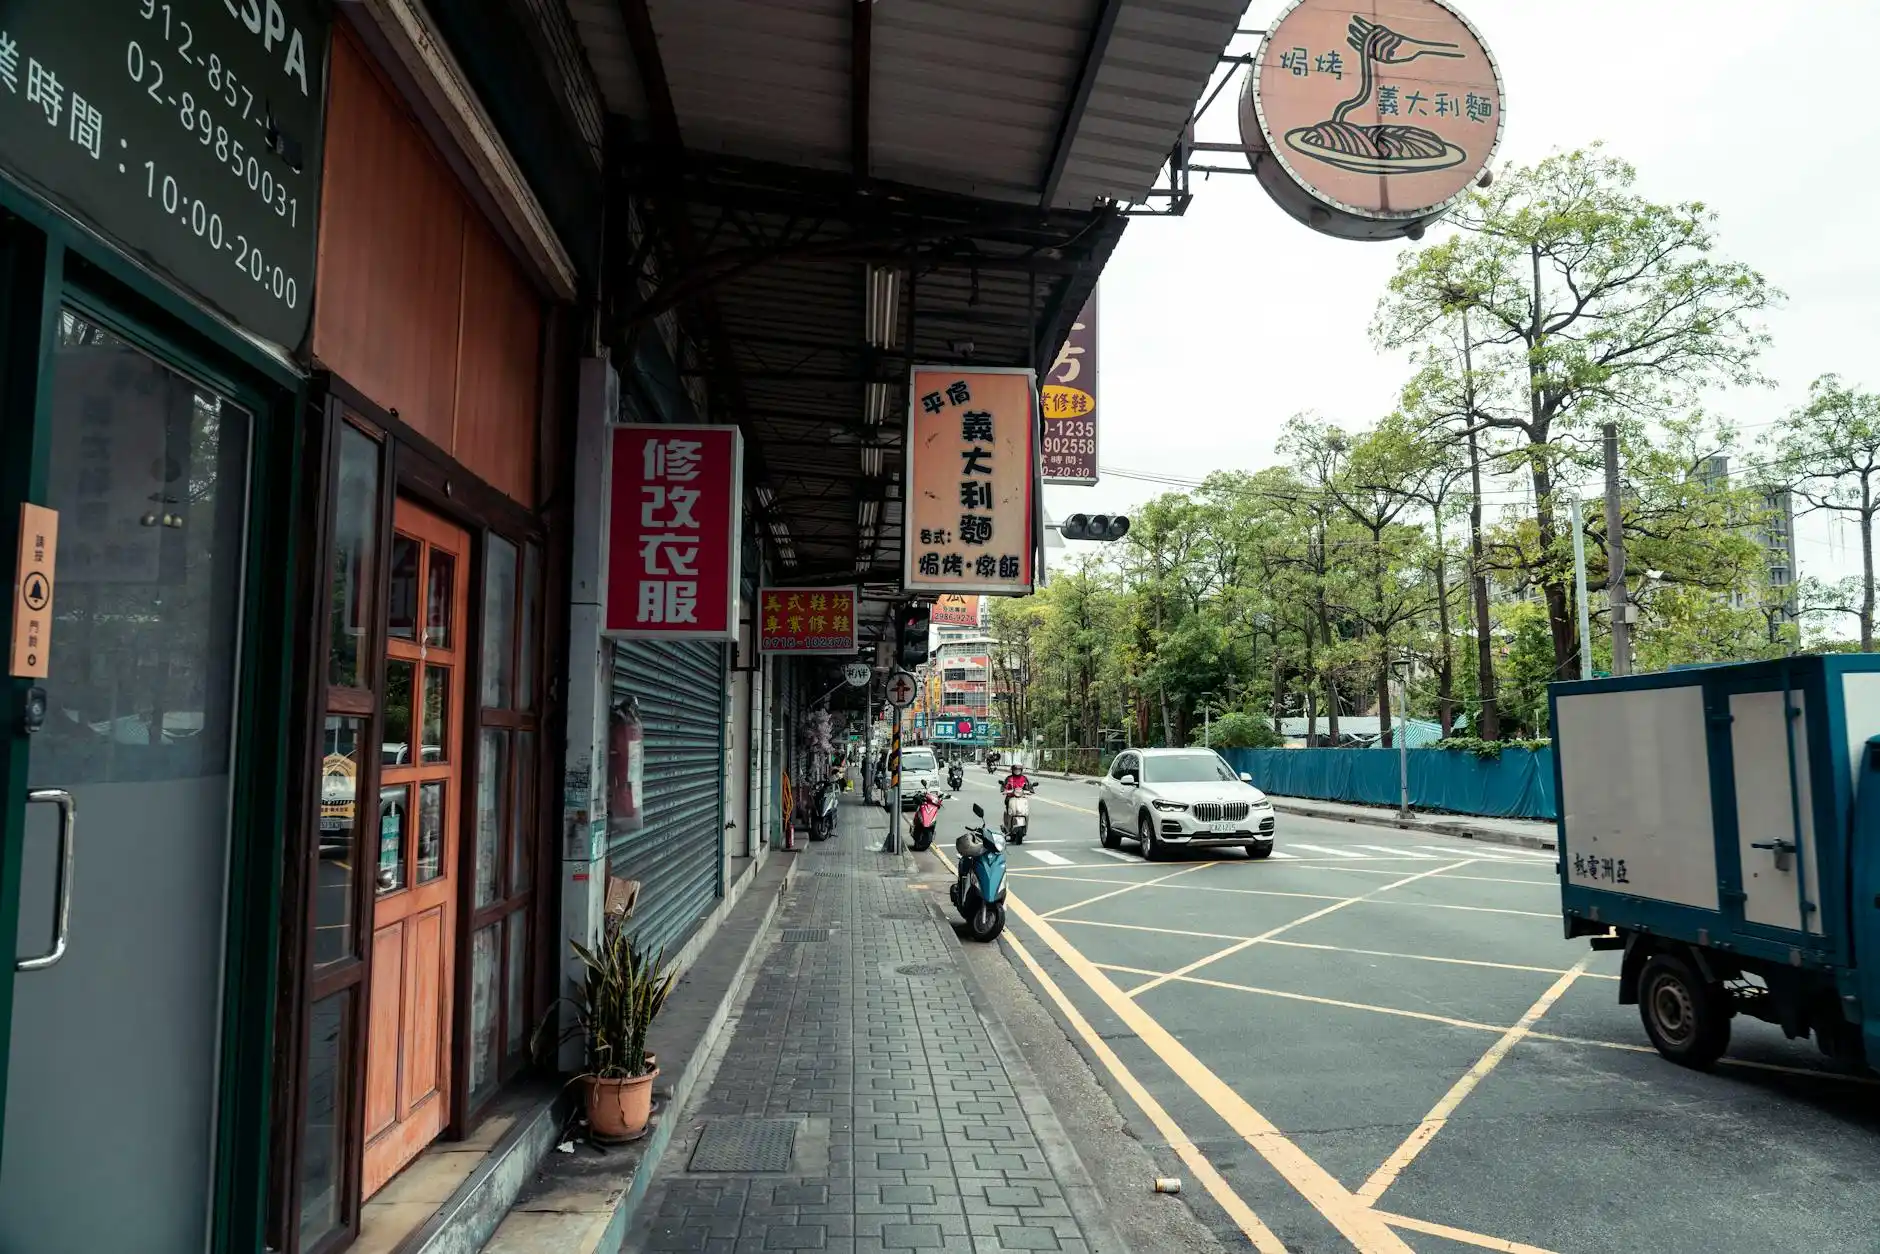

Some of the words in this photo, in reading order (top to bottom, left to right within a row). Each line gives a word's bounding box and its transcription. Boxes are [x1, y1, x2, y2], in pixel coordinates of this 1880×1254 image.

[127, 41, 297, 228] 02-89850031
[1378, 85, 1492, 123] 義大利麵
[637, 438, 703, 623] 修改衣服
[959, 410, 994, 545] 義大利麵
